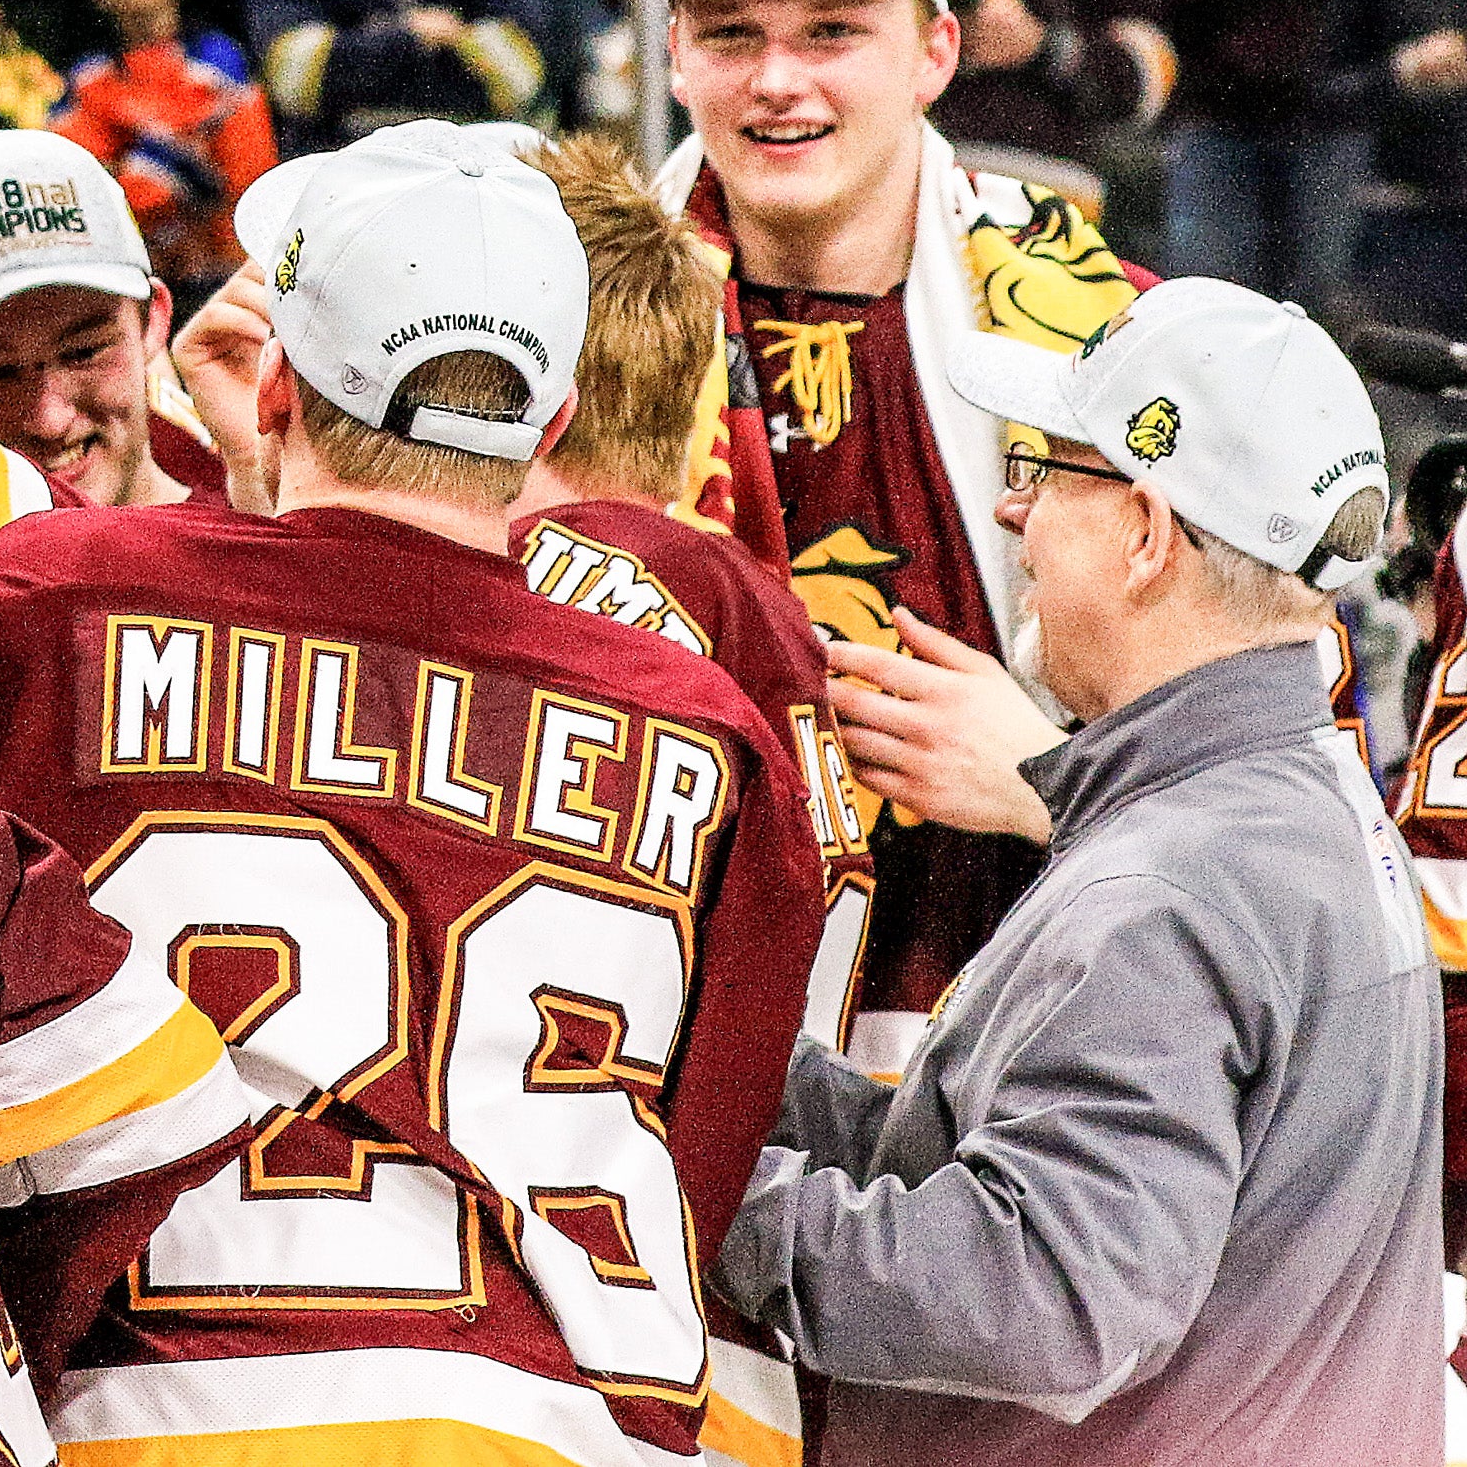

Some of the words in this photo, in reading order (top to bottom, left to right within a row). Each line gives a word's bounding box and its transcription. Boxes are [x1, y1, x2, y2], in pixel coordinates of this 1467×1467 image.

[381, 323, 422, 356] NCAA
[422, 313, 495, 335] NATIONAL
[1310, 463, 1343, 497] NCAA
[100, 613, 729, 907] MILLER
[84, 809, 712, 1409] 26
